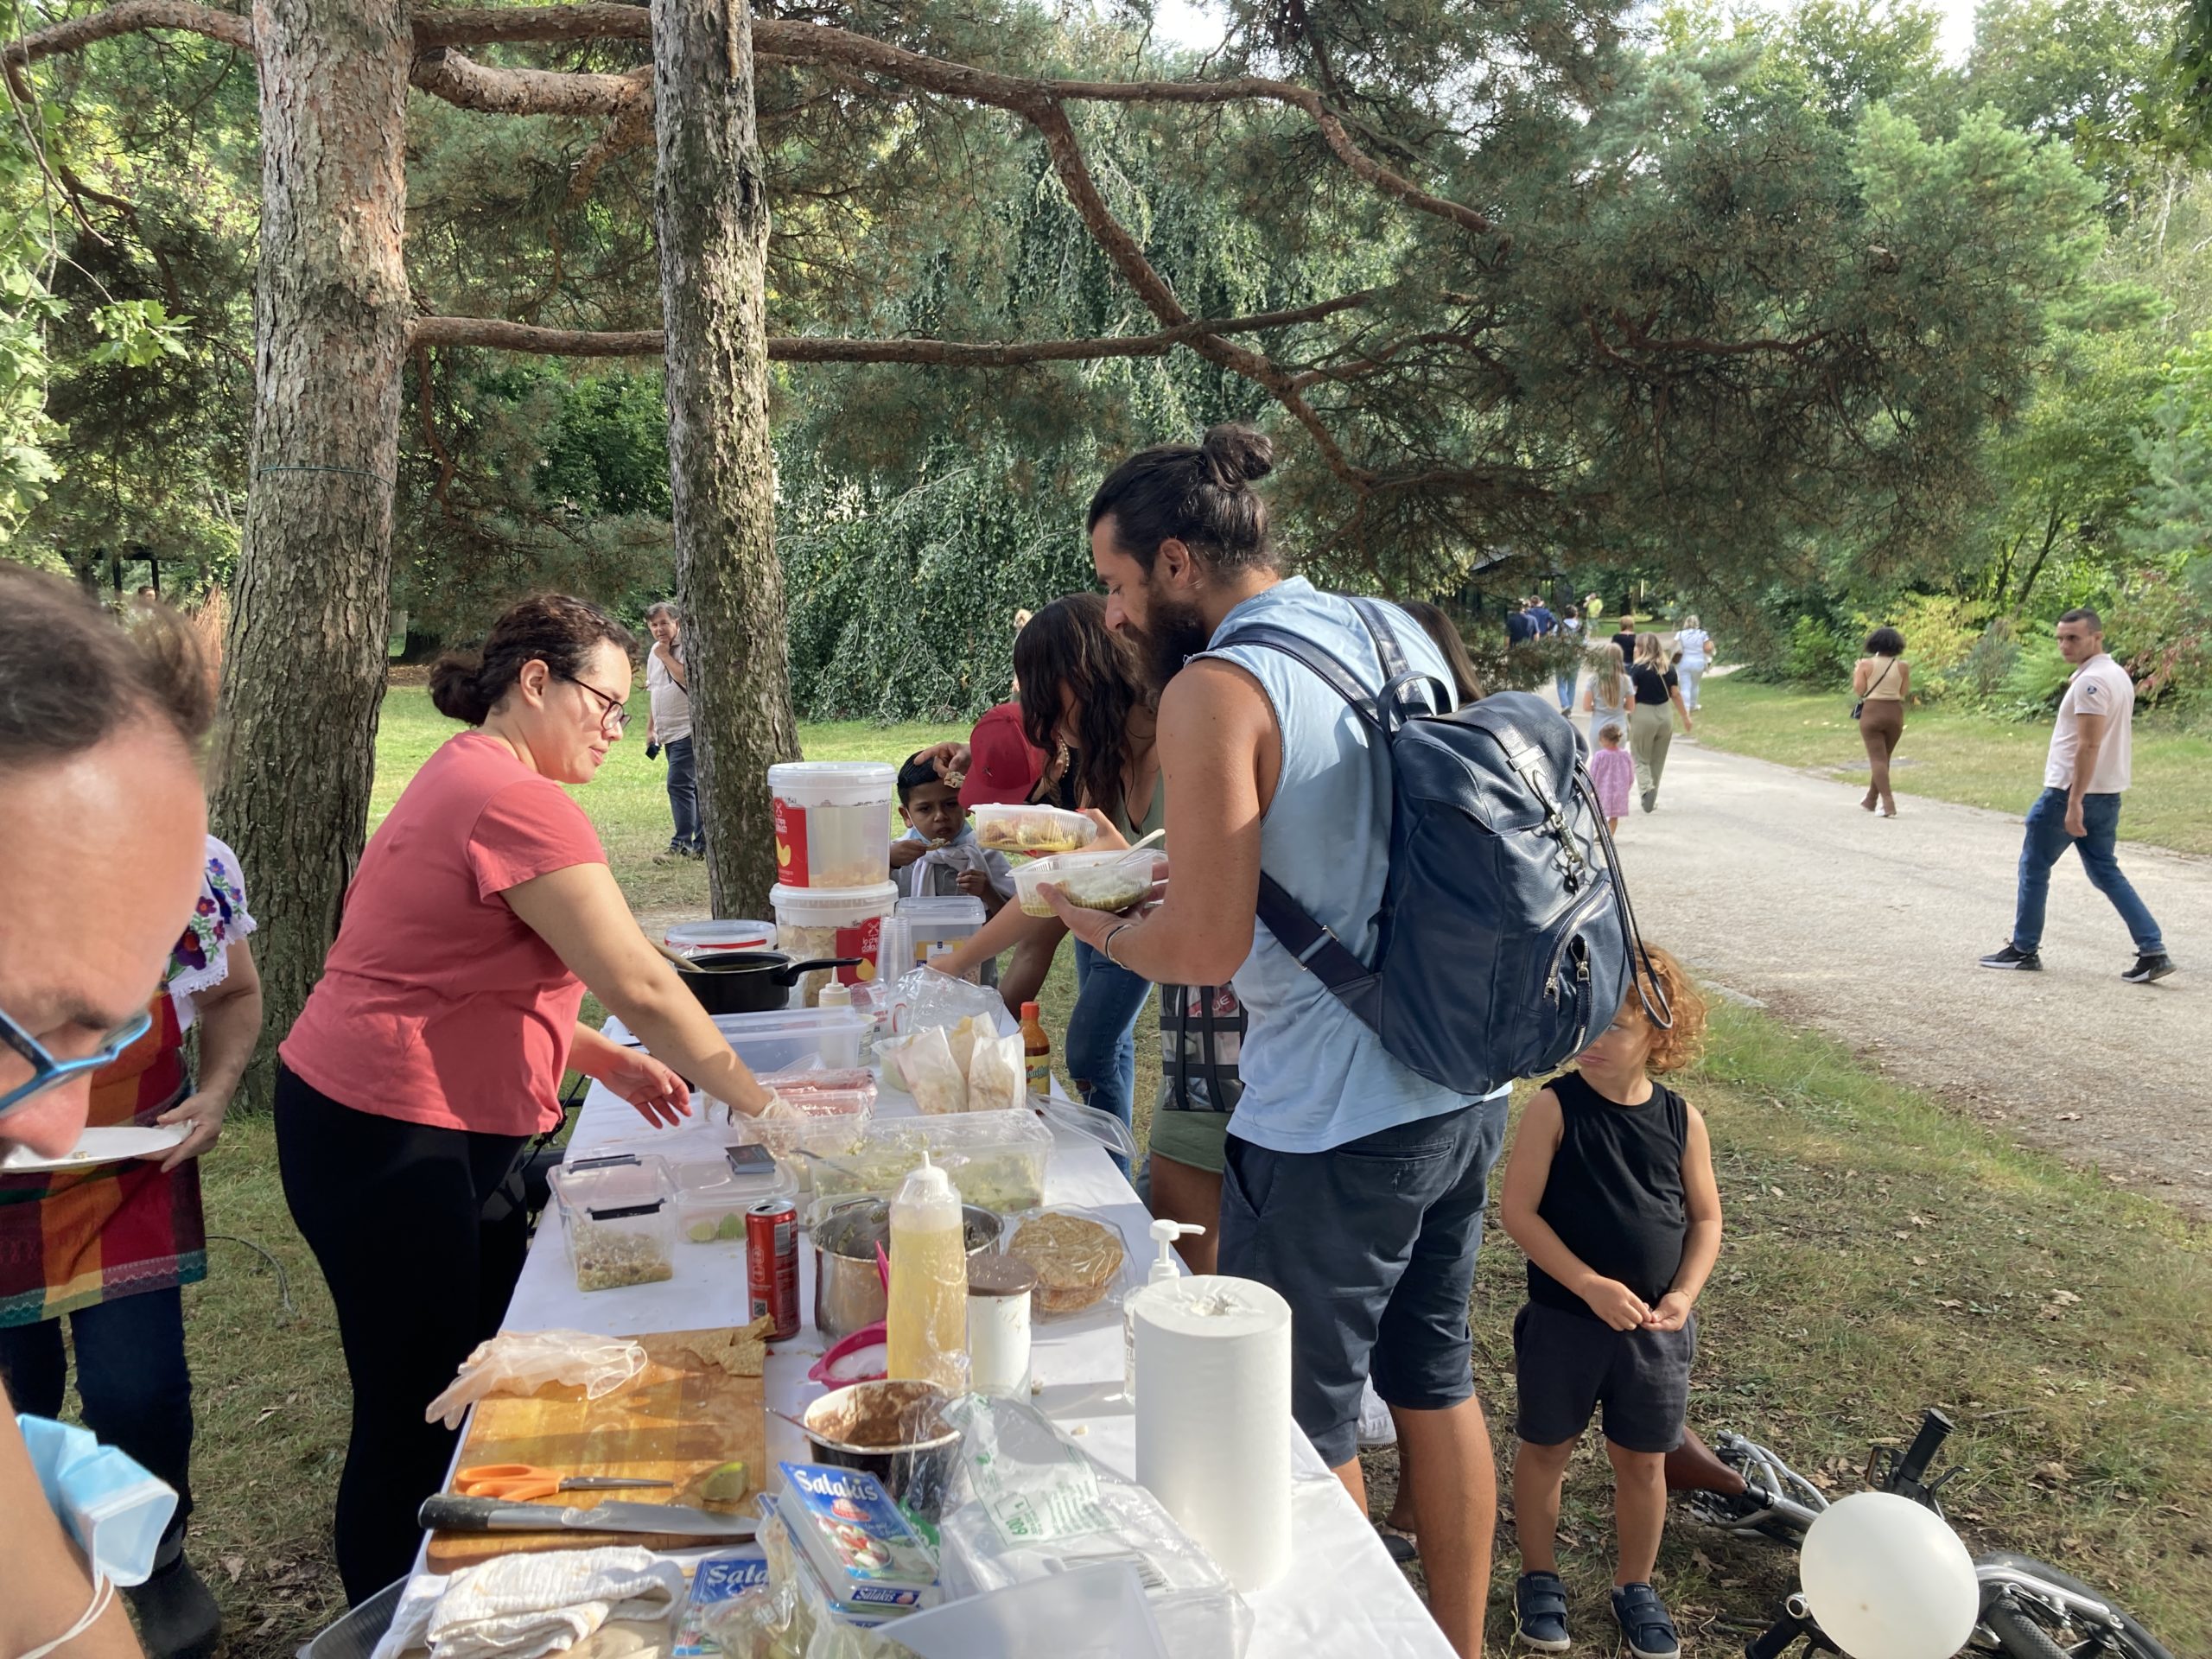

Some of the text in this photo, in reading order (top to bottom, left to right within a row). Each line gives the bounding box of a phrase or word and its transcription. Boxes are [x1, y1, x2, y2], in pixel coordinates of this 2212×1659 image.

[793, 1470, 879, 1502] Salakis
[706, 1564, 770, 1586] Sala
[855, 1588, 895, 1603] Salakis
